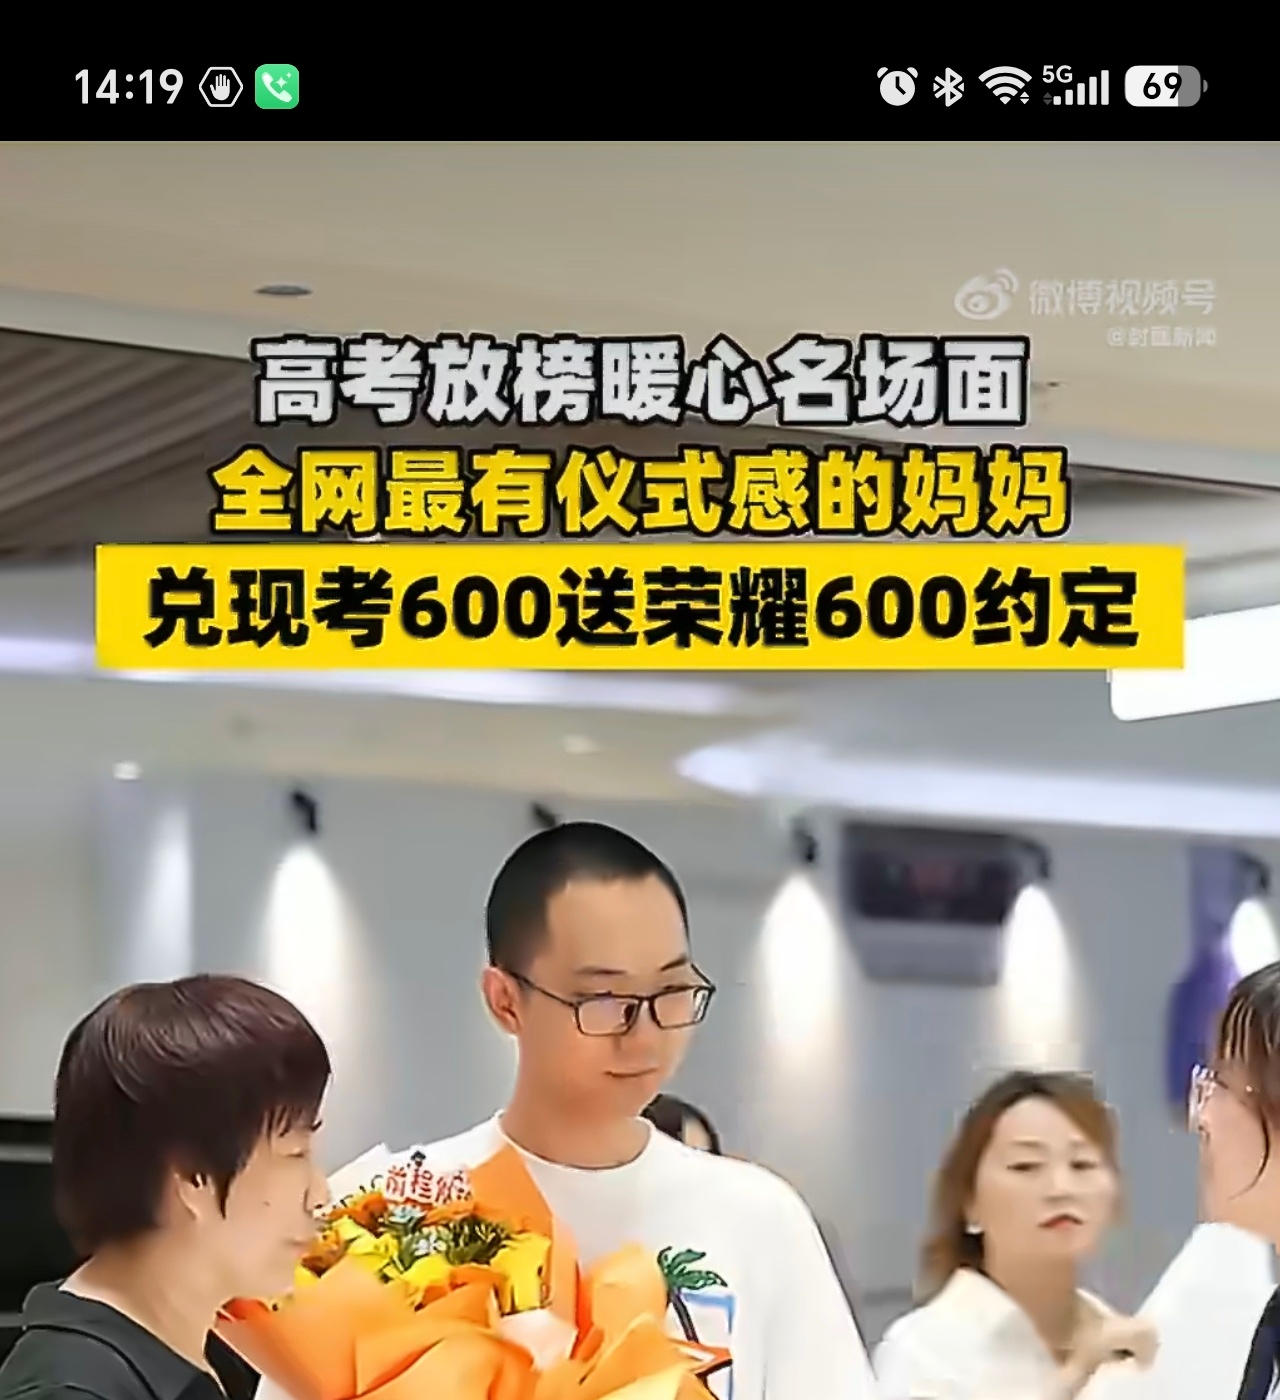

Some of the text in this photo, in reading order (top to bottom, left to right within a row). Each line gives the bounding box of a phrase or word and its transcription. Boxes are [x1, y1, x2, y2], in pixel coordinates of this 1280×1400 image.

[75, 68, 184, 105] 14:19
[1042, 64, 1073, 84] 5G
[1142, 72, 1183, 100] 69
